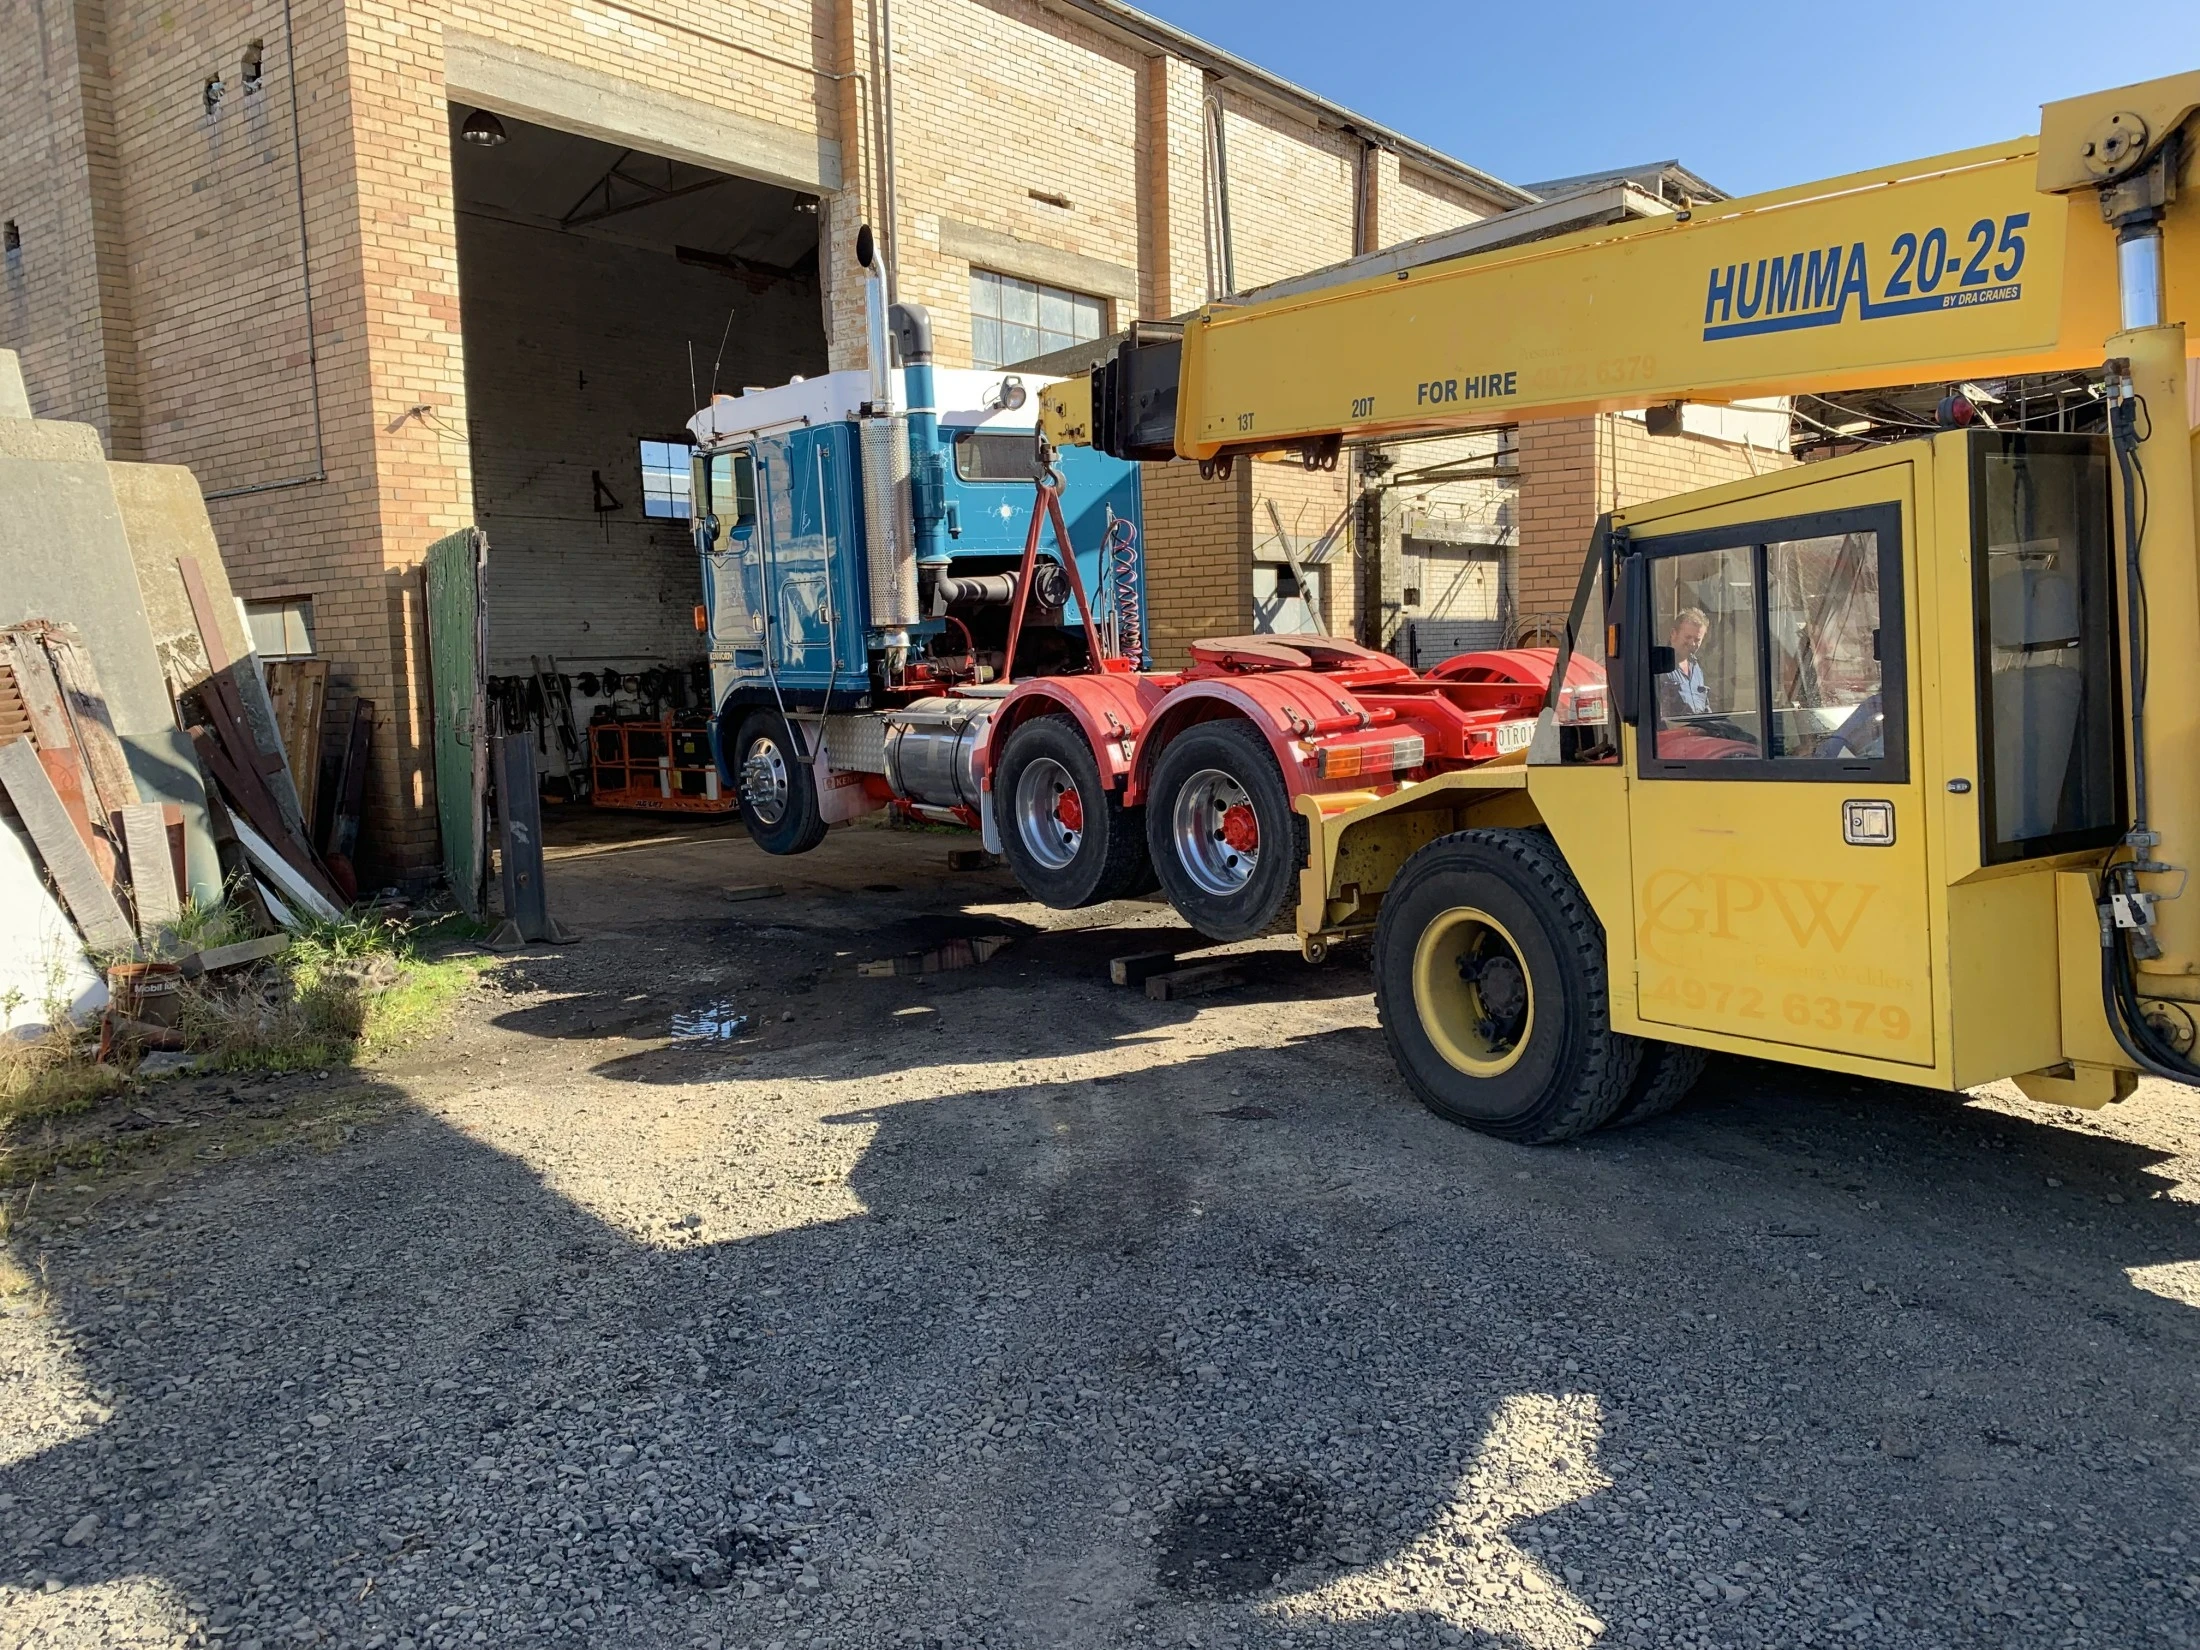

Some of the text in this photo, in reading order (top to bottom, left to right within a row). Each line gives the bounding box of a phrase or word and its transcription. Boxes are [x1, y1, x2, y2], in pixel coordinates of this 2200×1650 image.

[1705, 212, 2030, 323] HUMMA 20-25
[1942, 286, 2019, 307] BY DRA CRANES
[1596, 355, 1657, 385] 6379
[1417, 371, 1517, 405] FOR HIRE
[1237, 412, 1255, 431] 13T
[1351, 396, 1375, 418] 20T
[1639, 868, 1880, 968] GPW
[134, 983, 163, 992] Mobil
[1655, 975, 1912, 1042] 4972 6379
